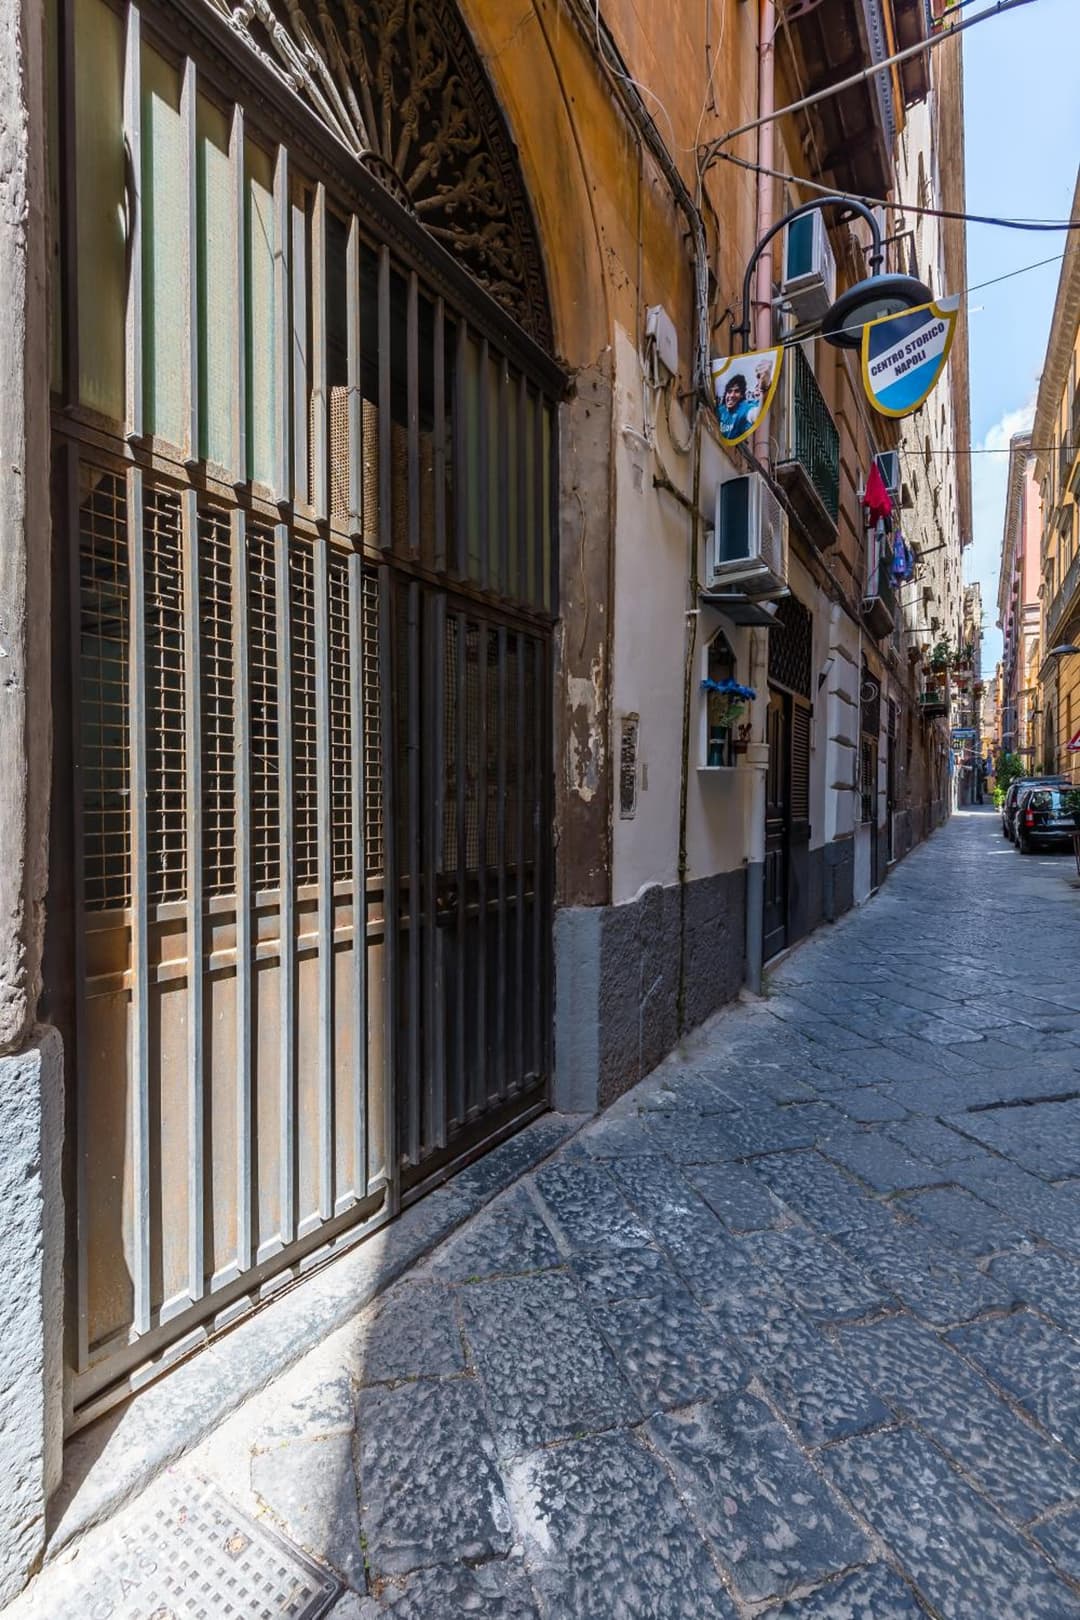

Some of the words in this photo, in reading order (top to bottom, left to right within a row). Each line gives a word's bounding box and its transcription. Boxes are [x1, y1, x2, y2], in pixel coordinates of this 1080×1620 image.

[871, 349, 904, 376] CENTRO
[905, 322, 945, 355] STORICO
[894, 350, 926, 376] NAPOLI
